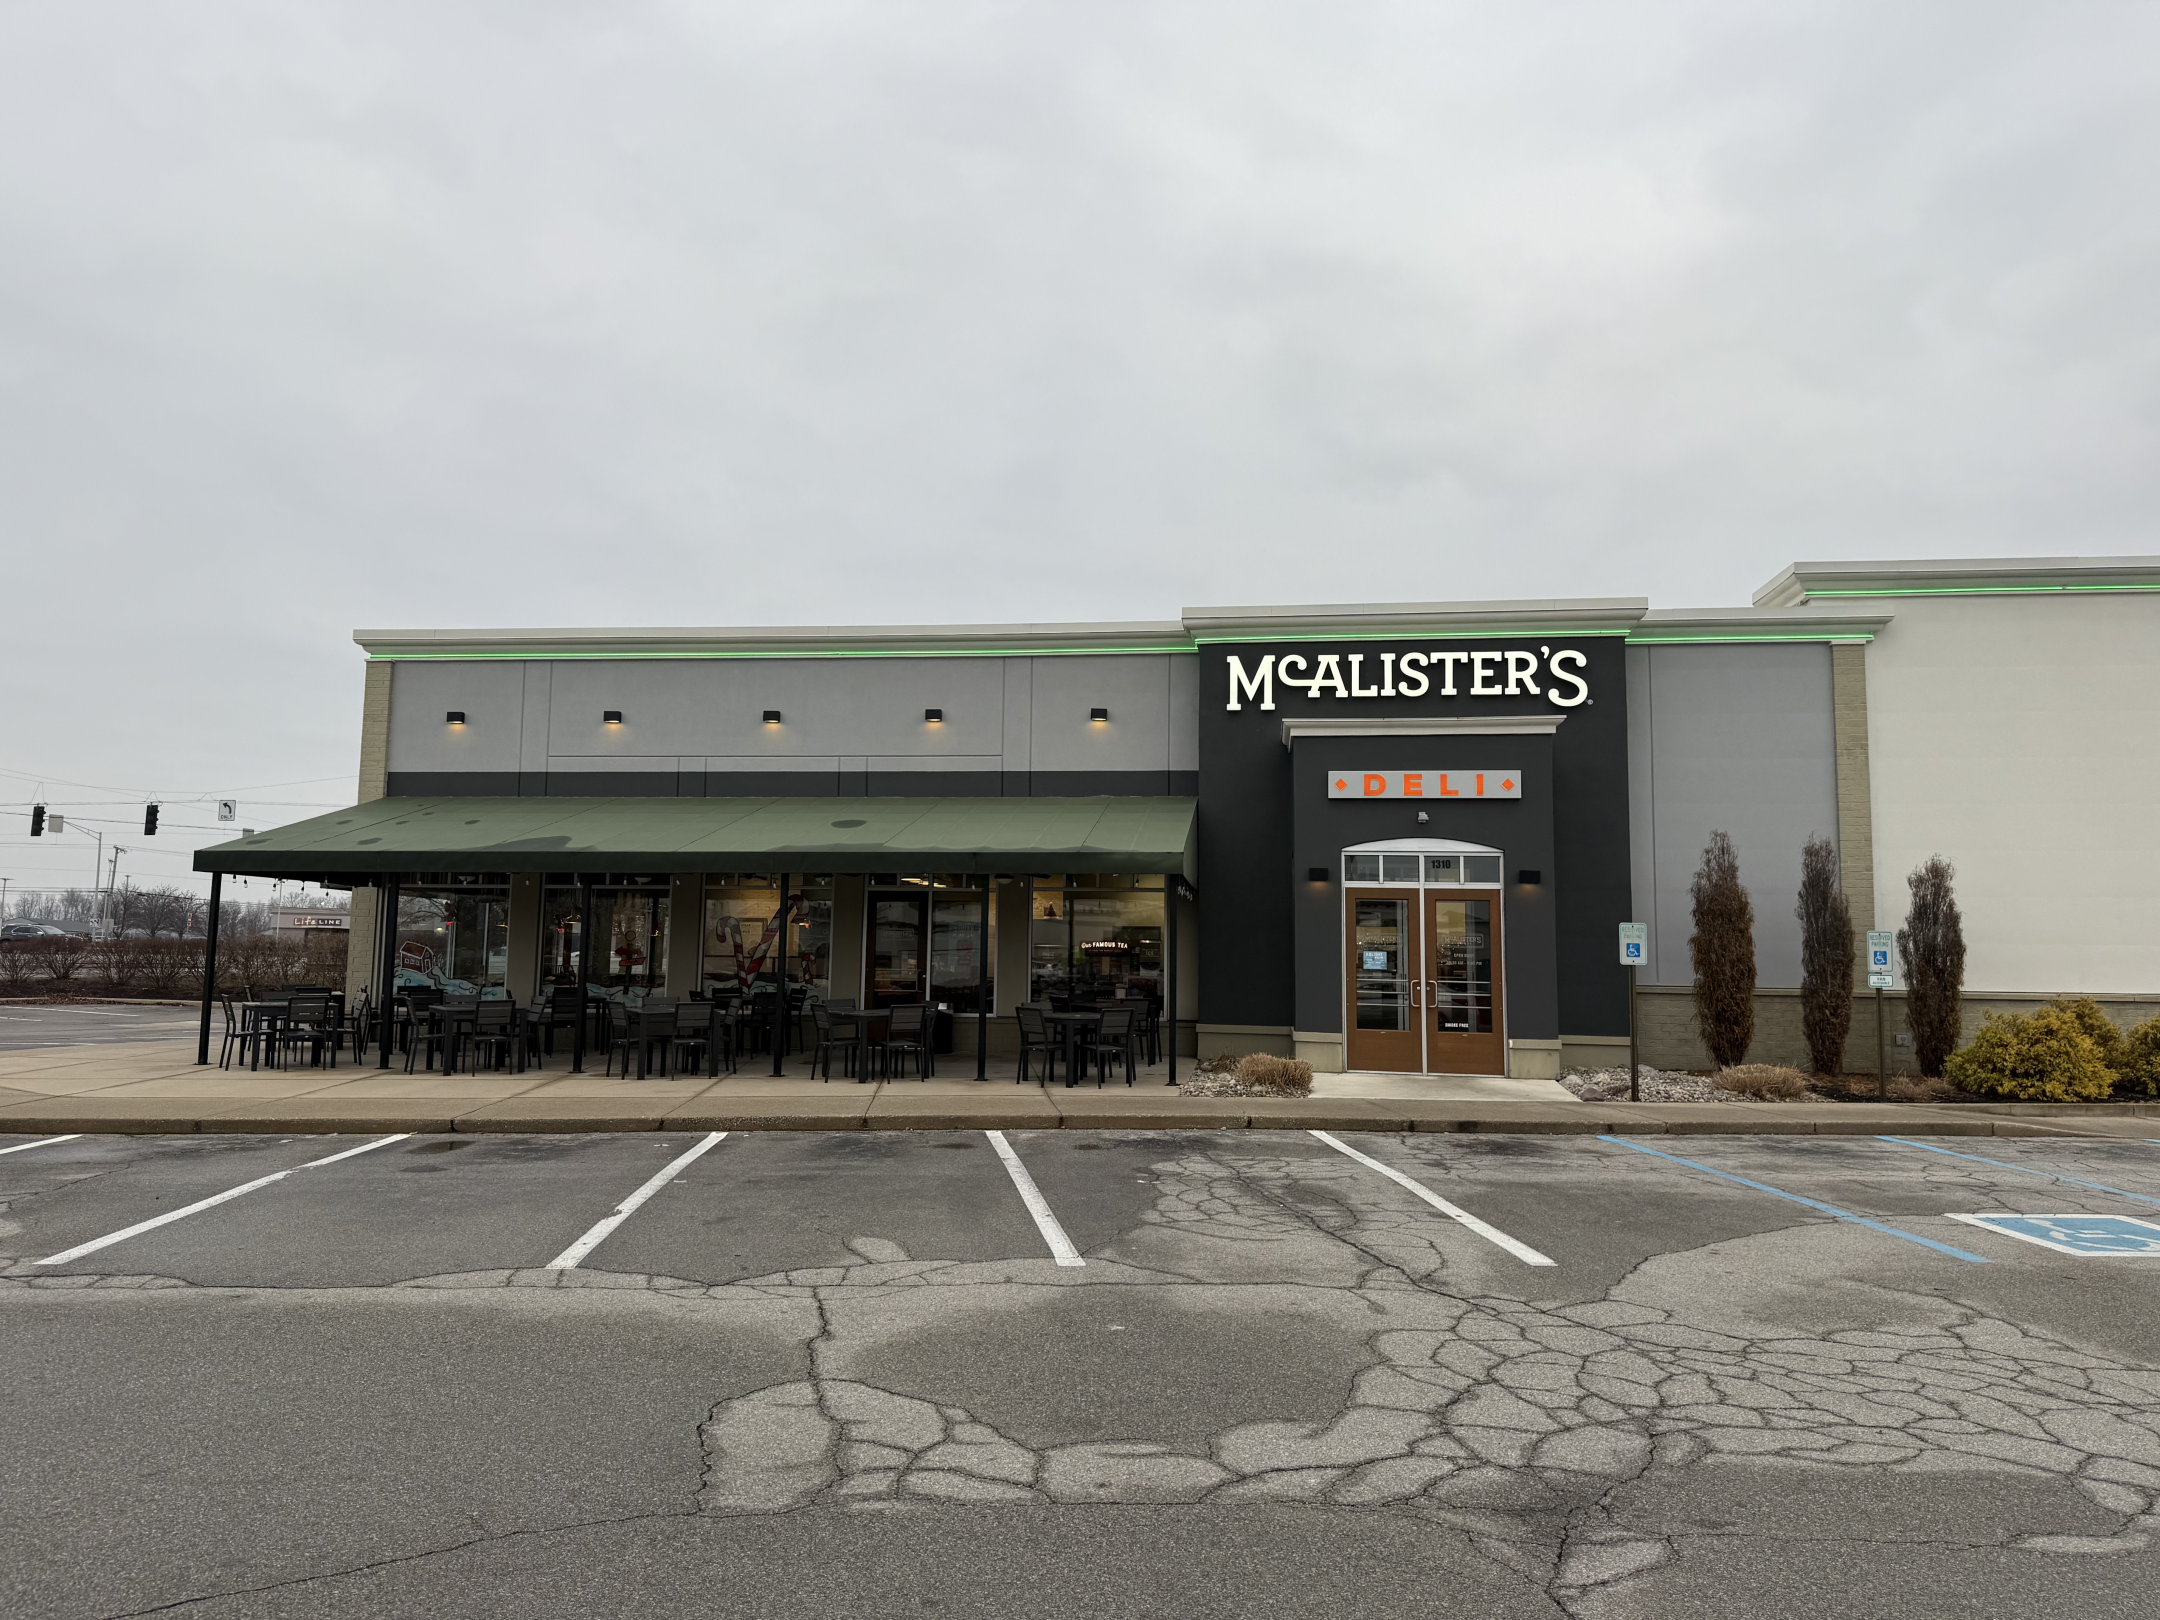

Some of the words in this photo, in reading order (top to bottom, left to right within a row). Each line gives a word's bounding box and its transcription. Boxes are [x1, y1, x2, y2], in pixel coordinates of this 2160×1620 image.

[1226, 645, 1588, 711] McALISTER'S
[1363, 773, 1484, 797] DELI
[1431, 859, 1451, 869] 1310
